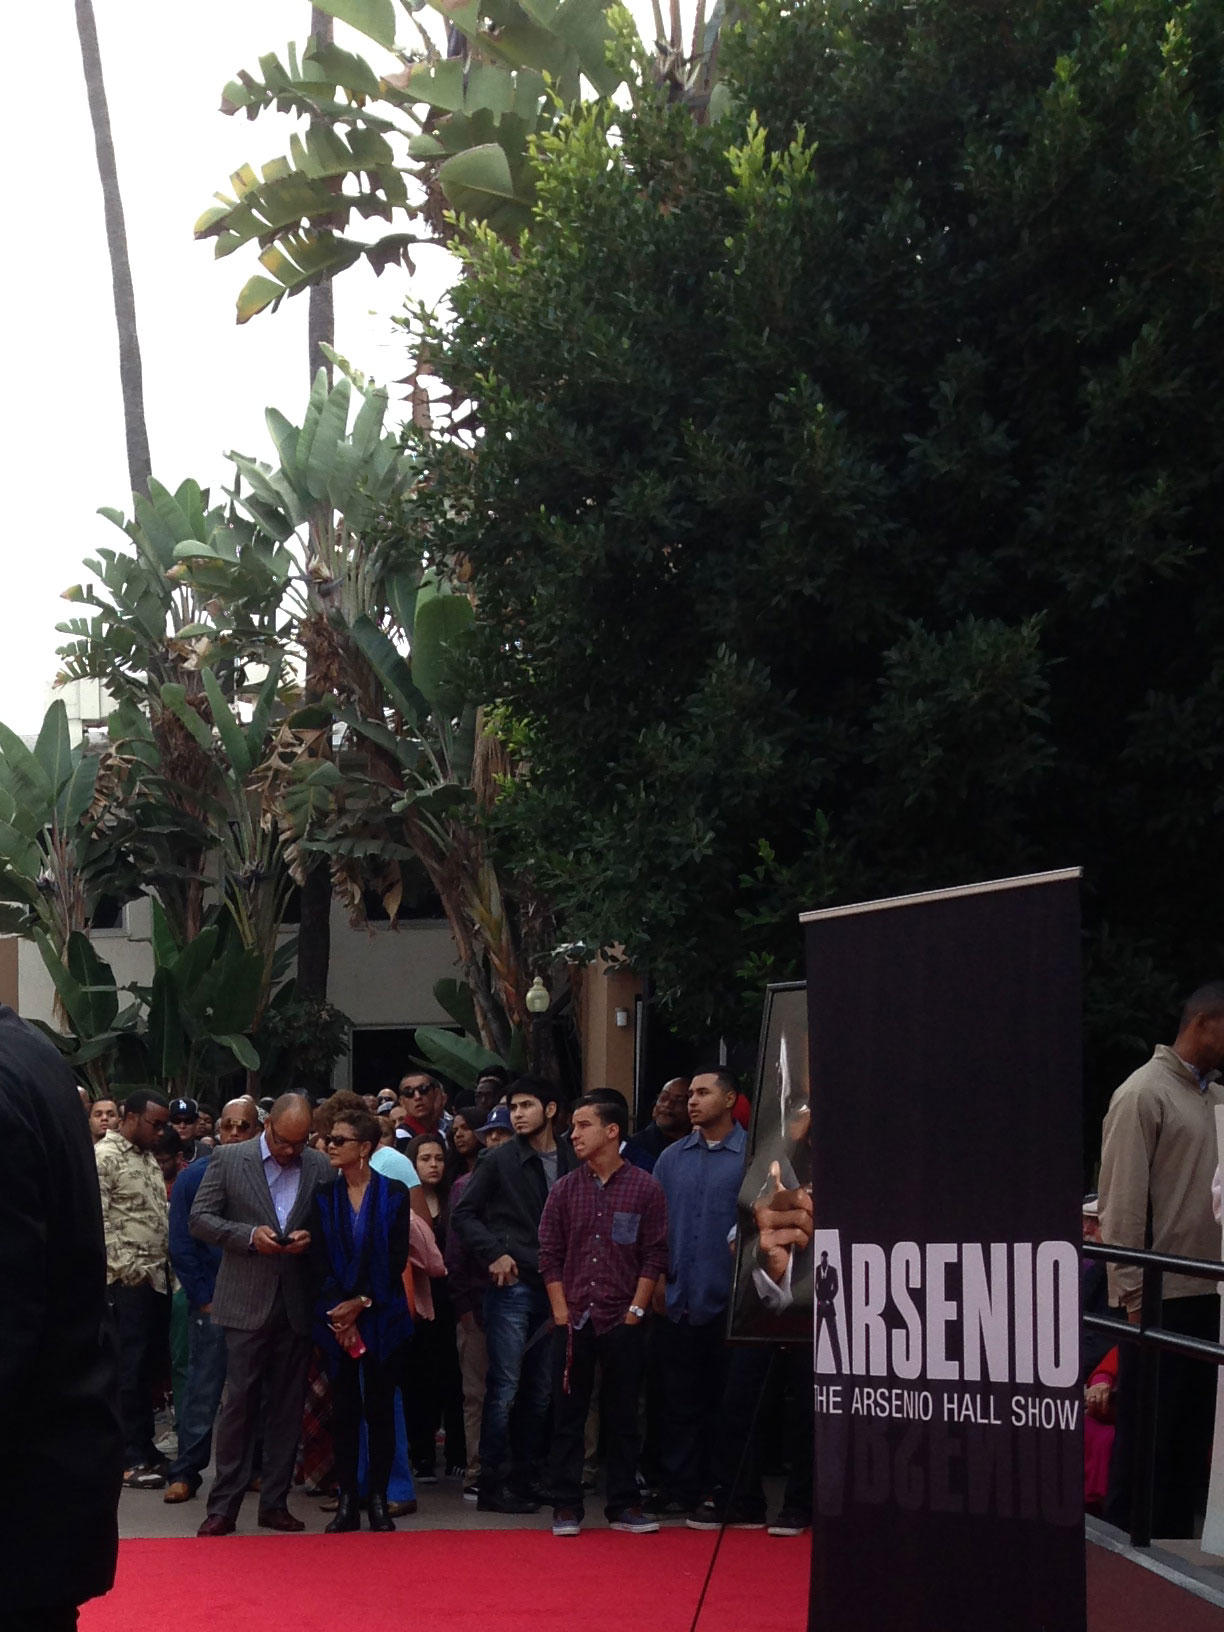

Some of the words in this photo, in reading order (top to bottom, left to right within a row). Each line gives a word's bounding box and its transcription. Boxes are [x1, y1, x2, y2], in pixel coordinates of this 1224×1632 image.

[814, 1228, 1080, 1388] ARSENIO
[851, 1389, 933, 1421] ARSENIO
[943, 1393, 1002, 1425] HALL
[1011, 1396, 1079, 1431] SHOW
